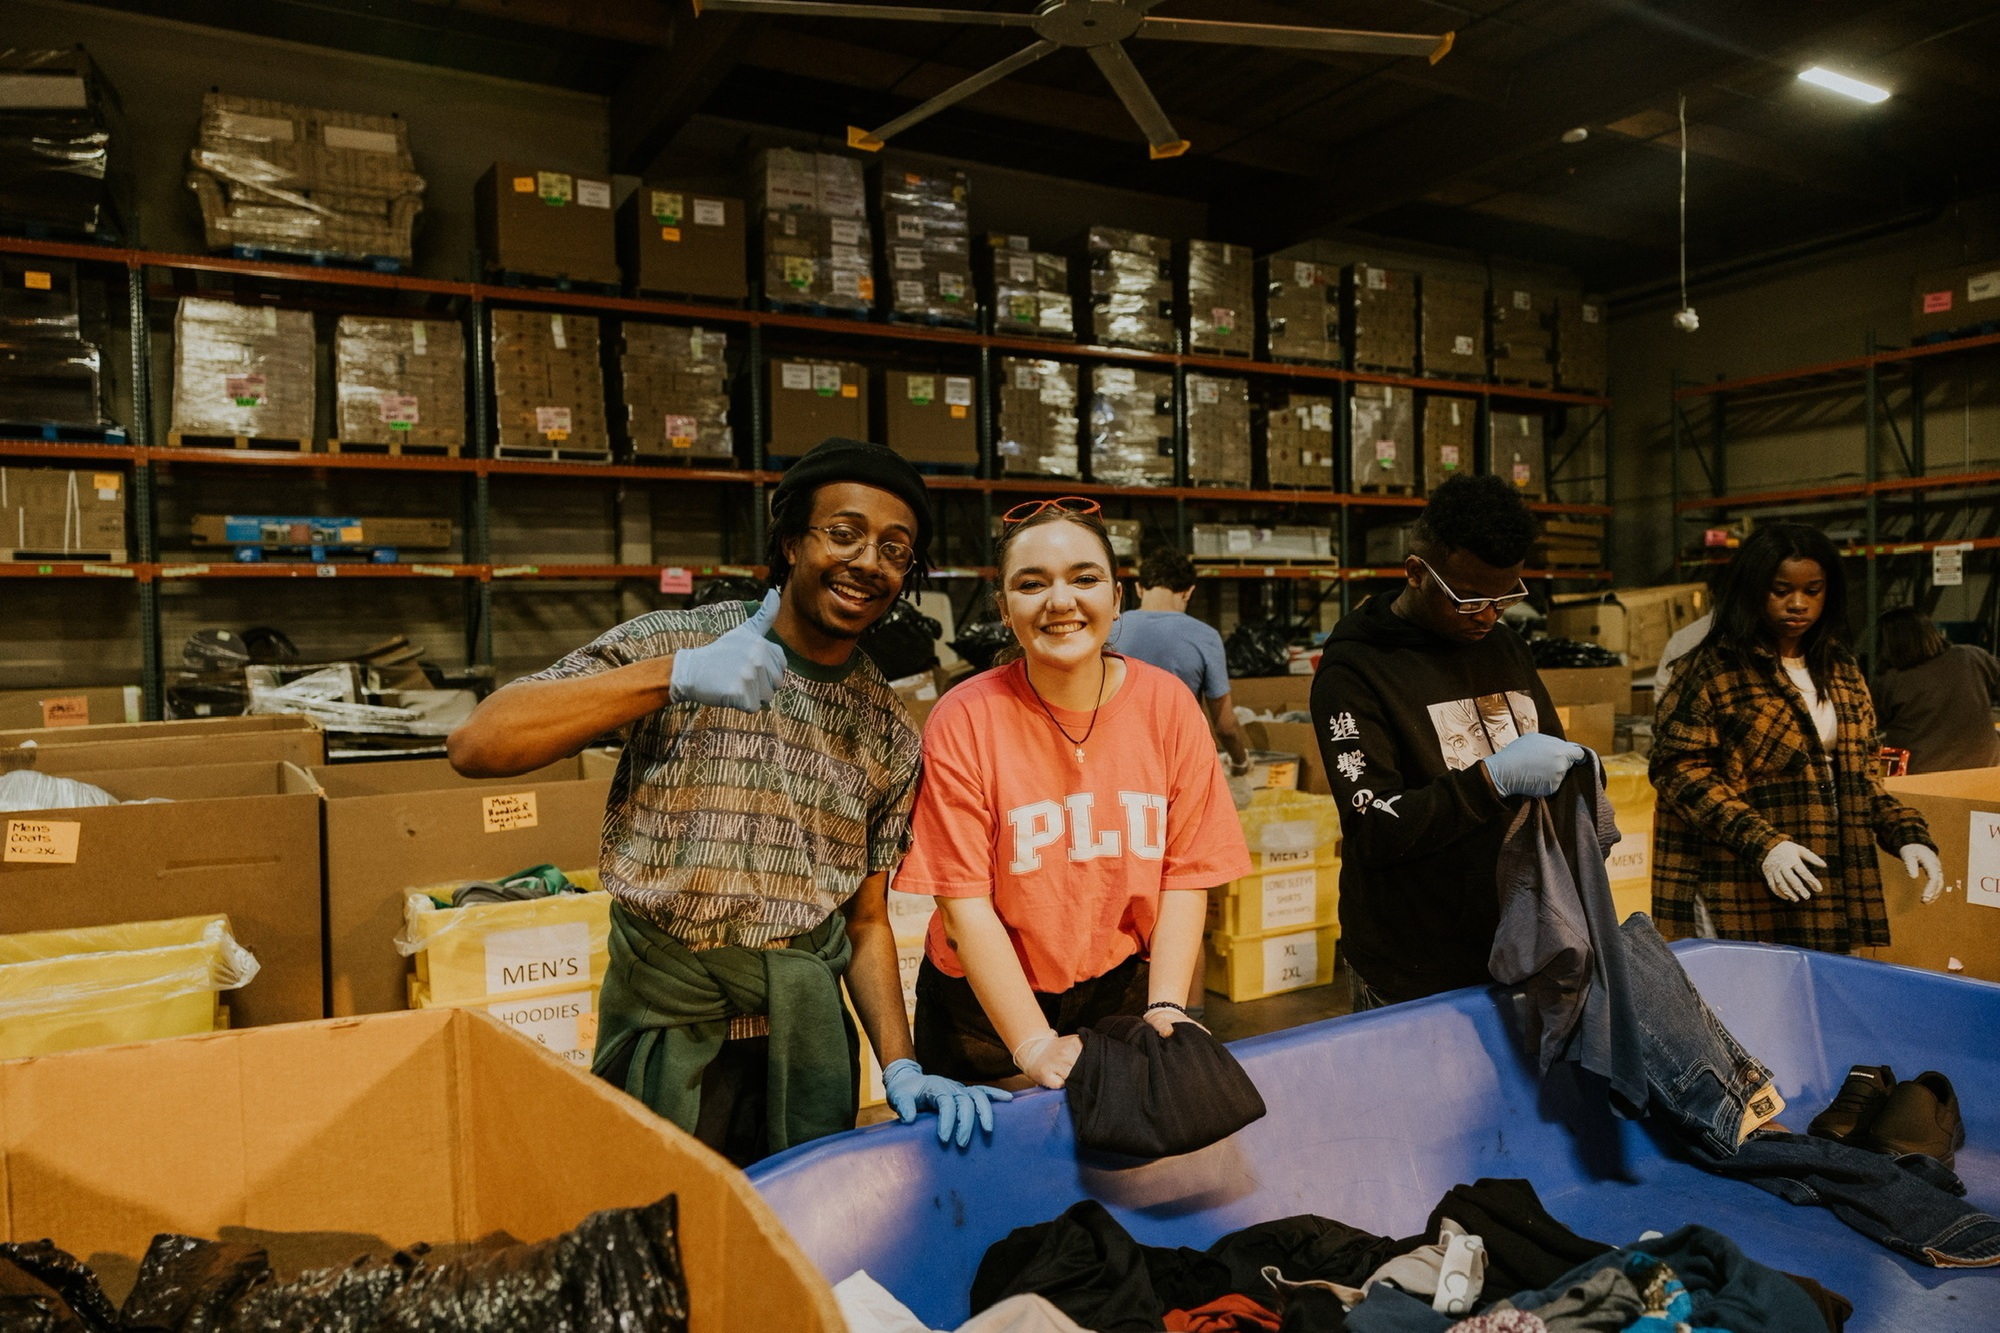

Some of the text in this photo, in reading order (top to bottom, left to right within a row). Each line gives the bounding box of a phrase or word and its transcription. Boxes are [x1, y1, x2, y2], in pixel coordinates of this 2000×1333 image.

[13, 823, 50, 832] Mens
[1008, 790, 1168, 875] PLU
[11, 833, 51, 843] Coats
[1269, 850, 1310, 862] MENS
[1612, 853, 1644, 867] MEN'S
[1284, 944, 1298, 957] XL
[503, 958, 578, 985] MEN'S
[1282, 966, 1302, 982] 2XL
[502, 1003, 580, 1026] HOODIES
